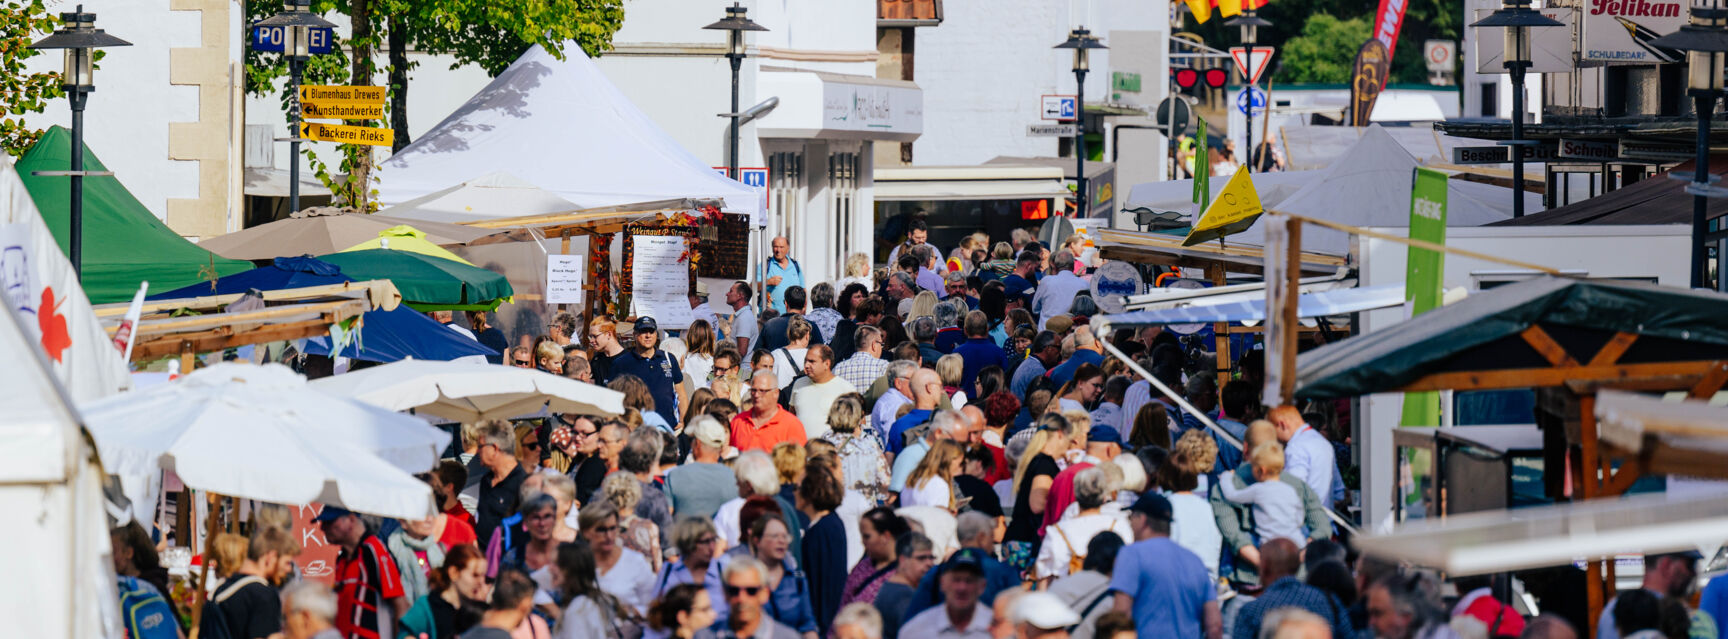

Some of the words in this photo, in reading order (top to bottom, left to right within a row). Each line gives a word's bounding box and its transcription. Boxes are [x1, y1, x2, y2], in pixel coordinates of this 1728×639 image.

[1590, 0, 1680, 17] Pelikan
[259, 26, 326, 48] POEI
[1588, 49, 1647, 59] SCHULBEDARF
[311, 88, 351, 100] Blumenhaus
[354, 89, 380, 100] Drewes
[313, 103, 382, 116] Kunsthandwerker
[319, 126, 357, 140] Bäckerei
[360, 130, 385, 142] Rieks
[1030, 126, 1073, 135] Marienstraße
